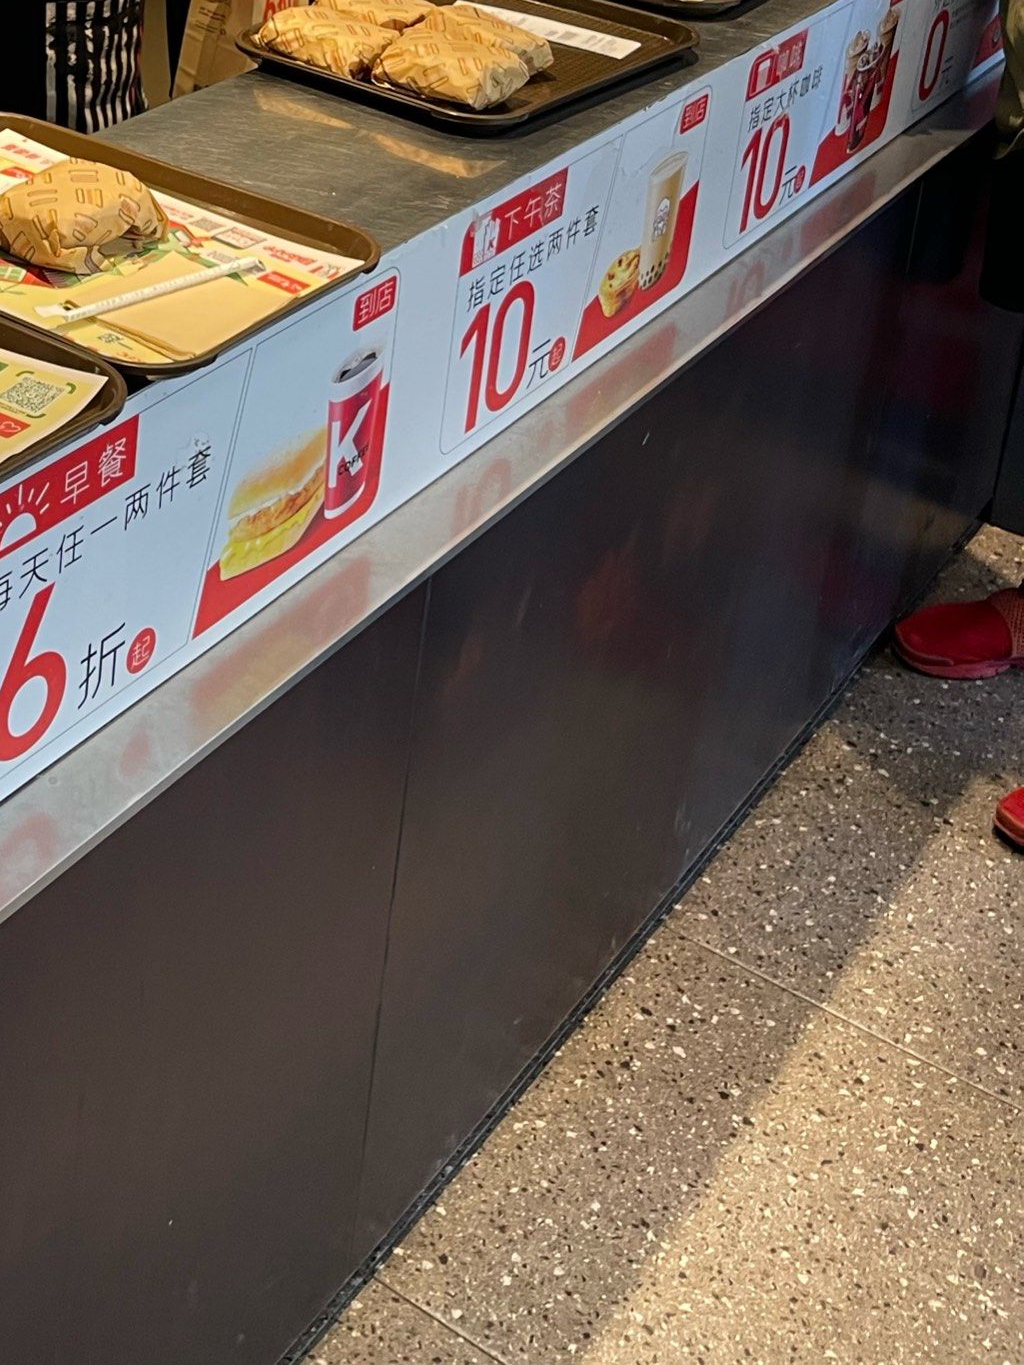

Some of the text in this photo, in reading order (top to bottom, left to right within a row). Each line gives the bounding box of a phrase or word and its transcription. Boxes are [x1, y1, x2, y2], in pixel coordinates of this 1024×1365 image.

[683, 97, 708, 132] 到店
[504, 182, 563, 242] 下午茶
[467, 205, 601, 314] 指定任选两件套
[356, 281, 396, 326] 到店
[61, 435, 129, 508] 早餐
[130, 634, 153, 668] 起
